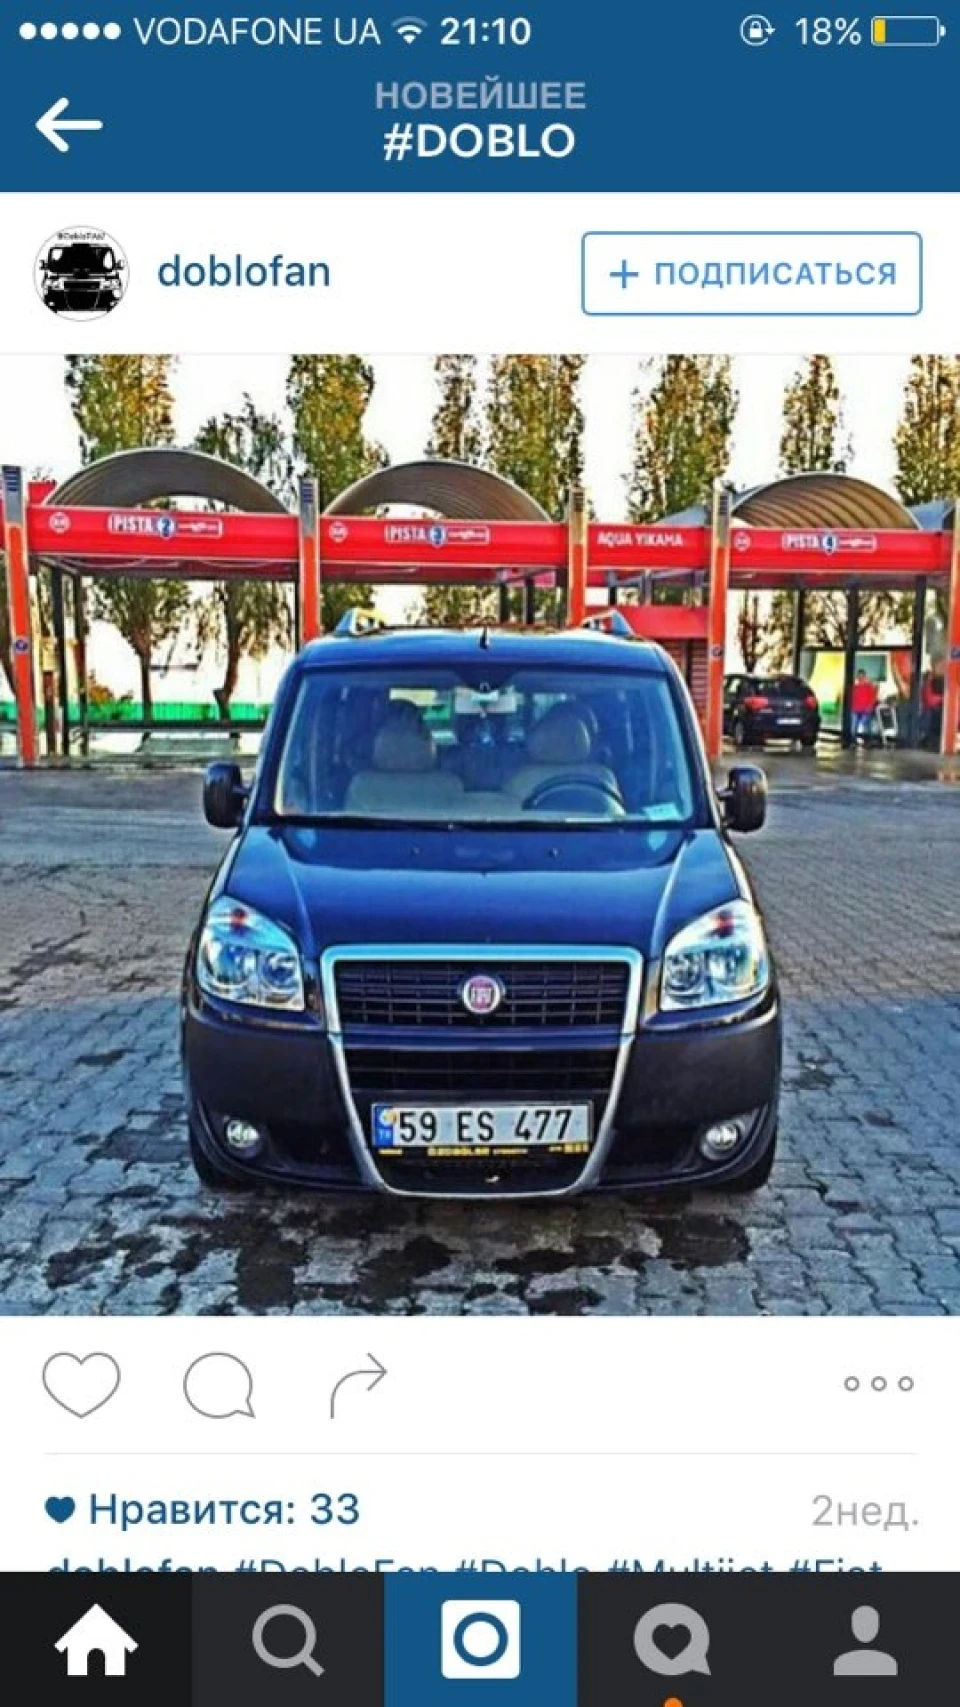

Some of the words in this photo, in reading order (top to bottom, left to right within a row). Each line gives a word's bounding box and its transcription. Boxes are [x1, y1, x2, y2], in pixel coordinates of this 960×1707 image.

[133, 17, 323, 46] VODAFONE
[335, 17, 382, 46] UA
[440, 17, 532, 46] 21:10
[795, 17, 862, 46] 18%
[376, 76, 586, 110] НОВЕЙШЕЕ
[383, 123, 576, 161] #DOBLO
[157, 253, 330, 288] doblofan
[655, 261, 897, 289] ПОДПИСАТЬСЯ
[112, 514, 154, 533] PISTA
[390, 526, 427, 543] PISTA
[597, 532, 632, 547] AQUA
[636, 533, 683, 547] YIKAMA
[786, 534, 819, 549] PISTA
[399, 1111, 437, 1143] 59
[457, 1111, 494, 1143] ES
[515, 1109, 572, 1141] 477
[89, 1493, 295, 1532] Нравится:
[310, 1493, 360, 1524] 33
[812, 1495, 919, 1532] 2нед.
